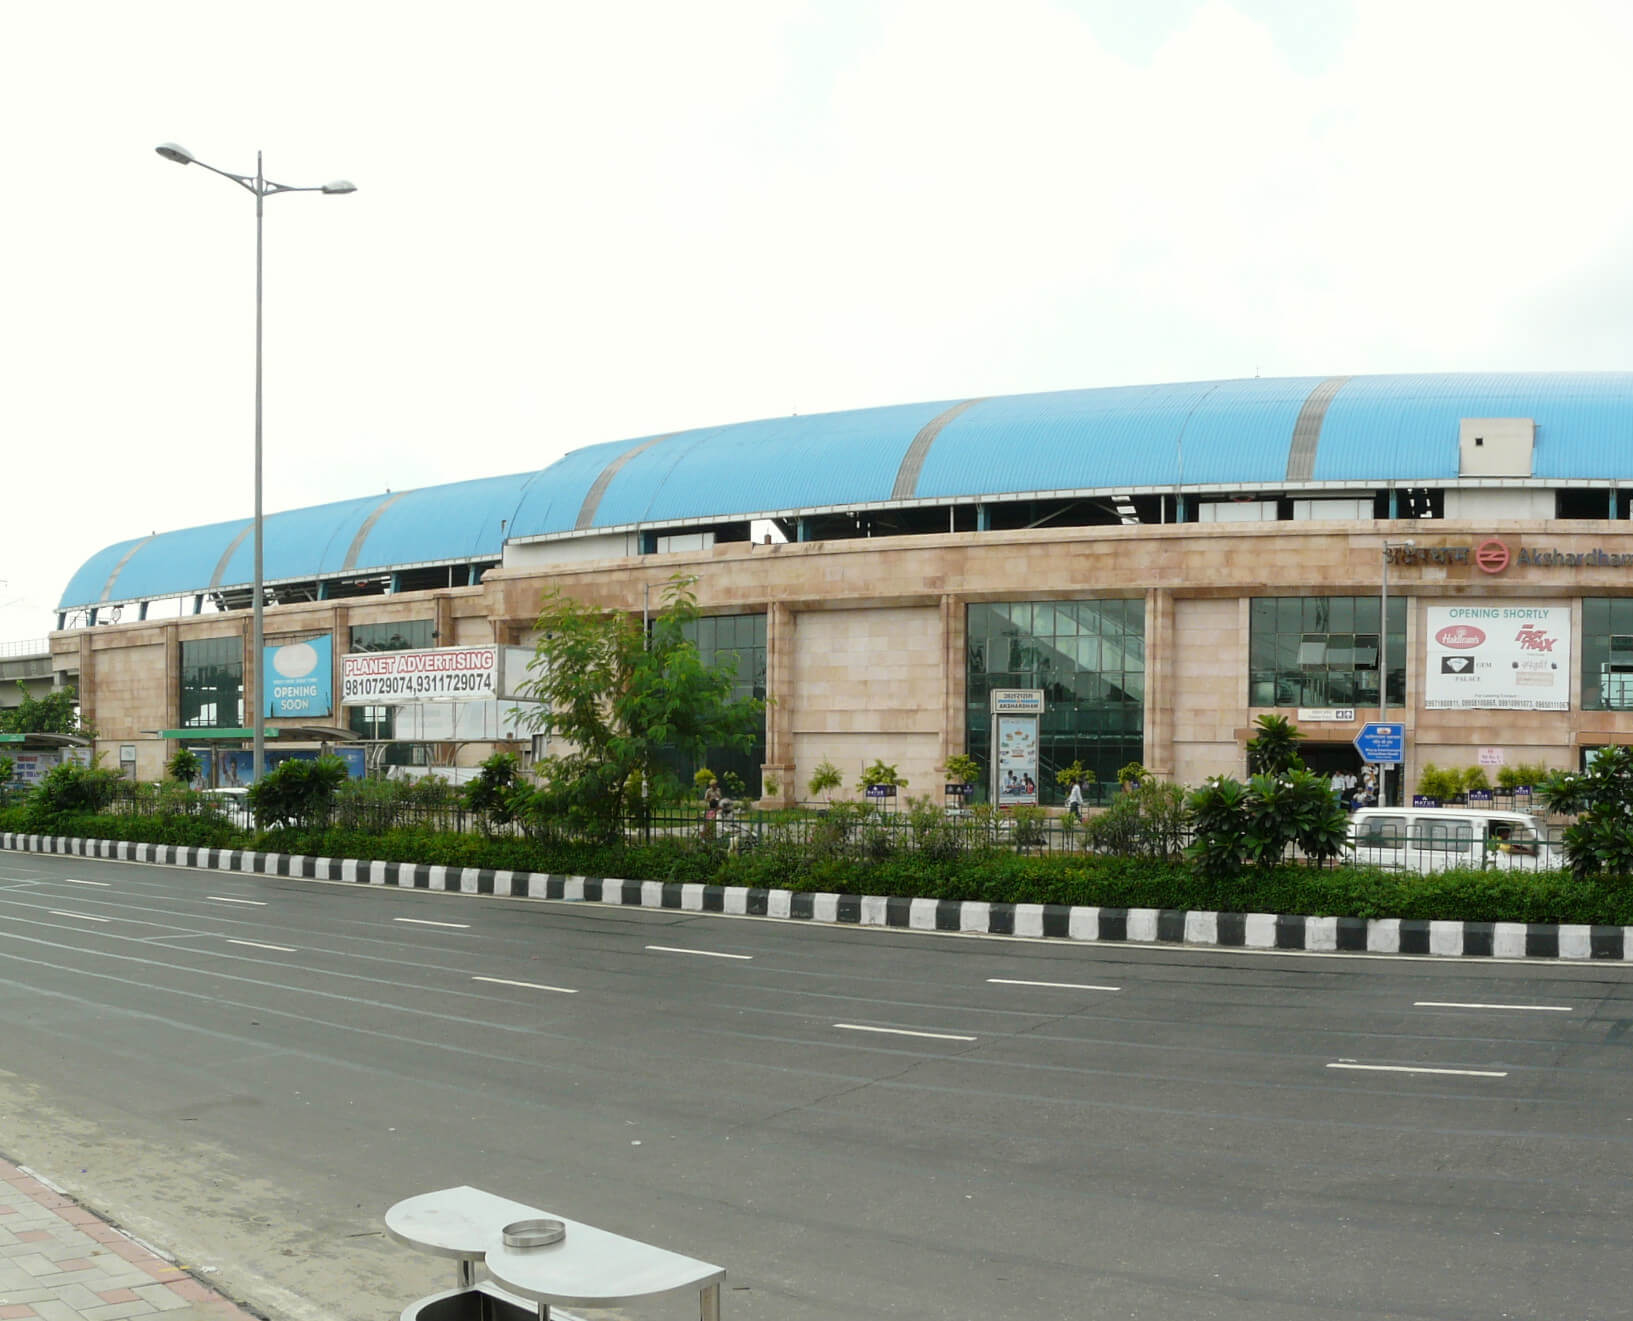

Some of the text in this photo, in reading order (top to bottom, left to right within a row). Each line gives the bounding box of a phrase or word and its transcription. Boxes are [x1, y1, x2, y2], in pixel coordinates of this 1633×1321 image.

[1449, 608, 1549, 619] OPENING SHORTLY
[345, 651, 494, 677] PLANET ADVERTISING
[273, 685, 317, 698] OPENING
[281, 699, 309, 710] SOON
